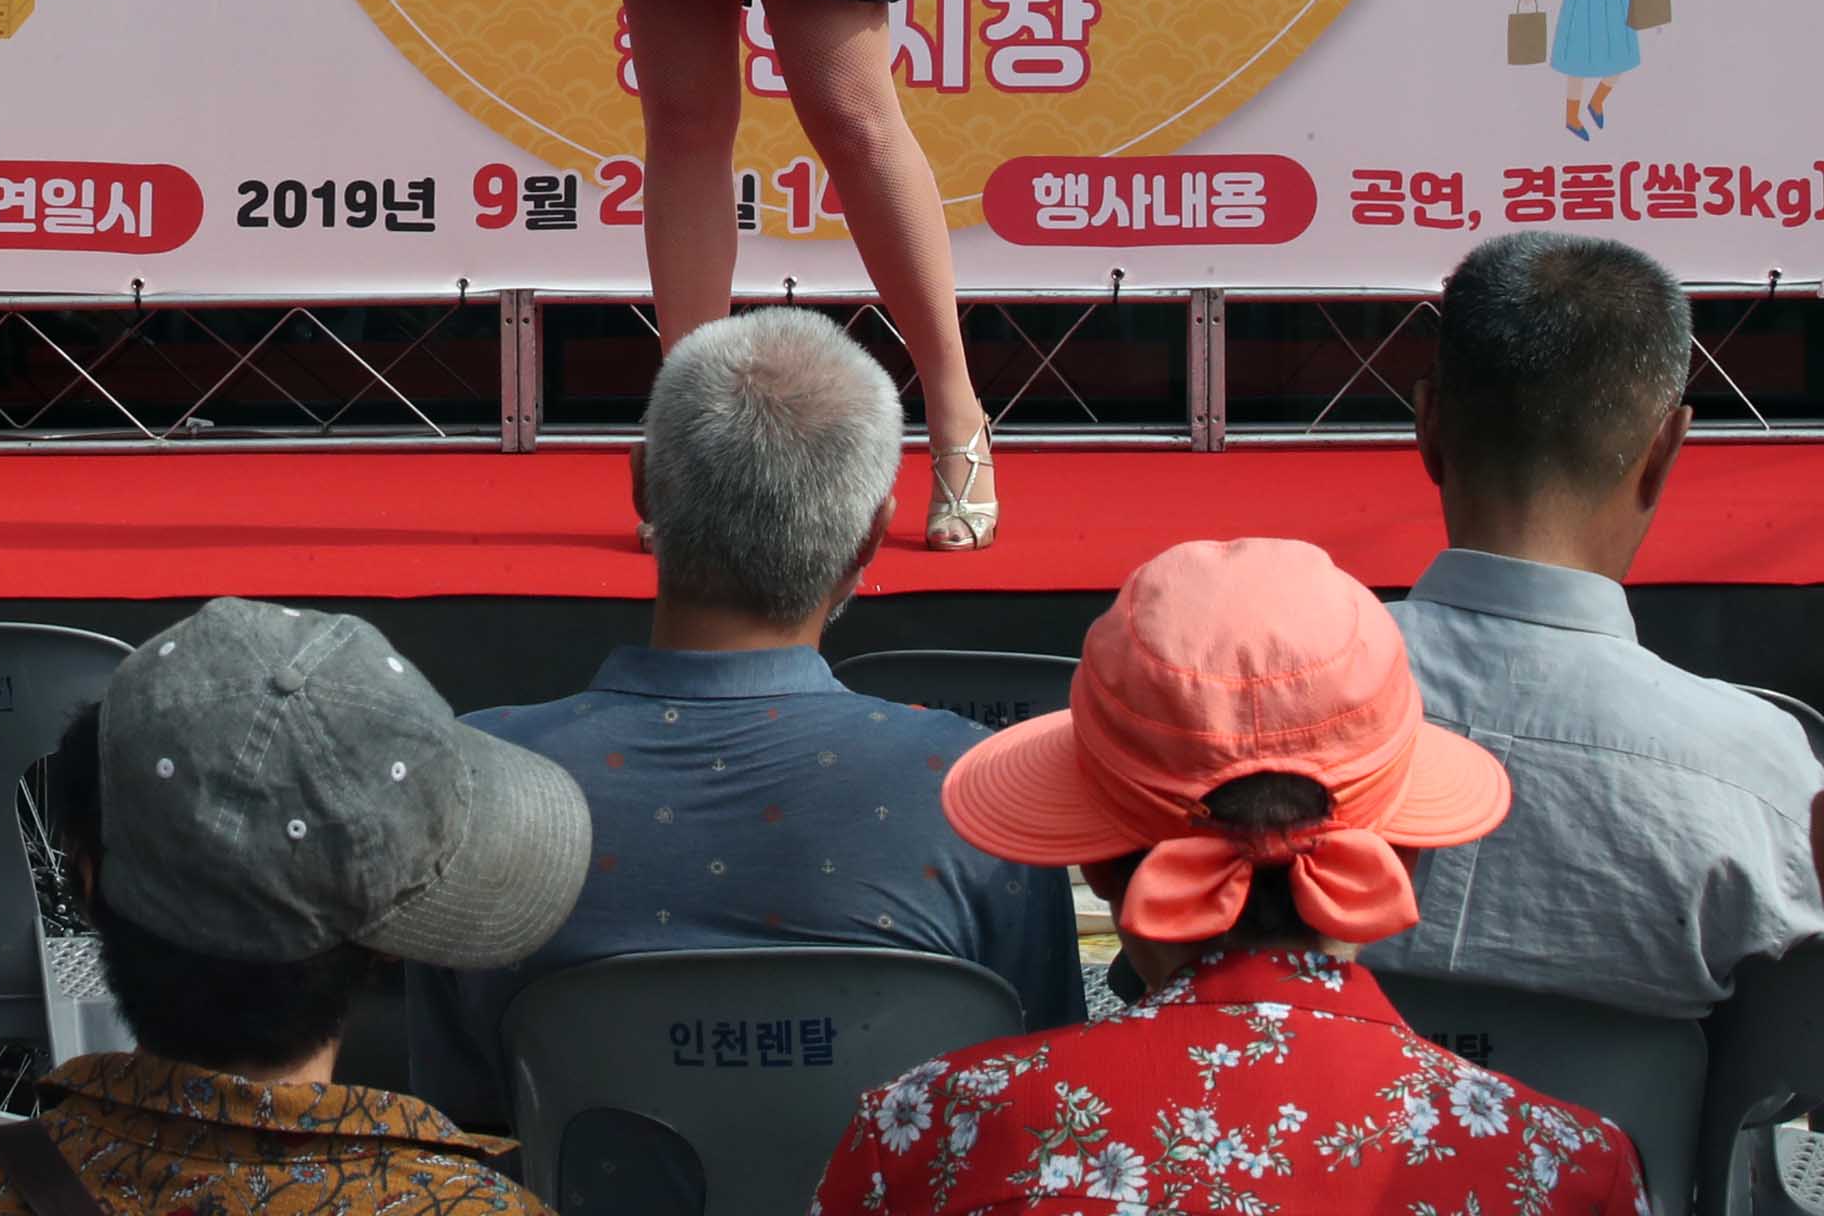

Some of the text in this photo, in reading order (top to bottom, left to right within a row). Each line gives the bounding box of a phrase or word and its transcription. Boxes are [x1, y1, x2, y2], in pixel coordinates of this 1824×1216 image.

[235, 178, 437, 233] 2019년
[472, 163, 578, 231] 9월
[1031, 170, 1267, 230] 행사내용
[1349, 169, 1483, 232] 공연,
[669, 1016, 838, 1068] 인천렌탈
